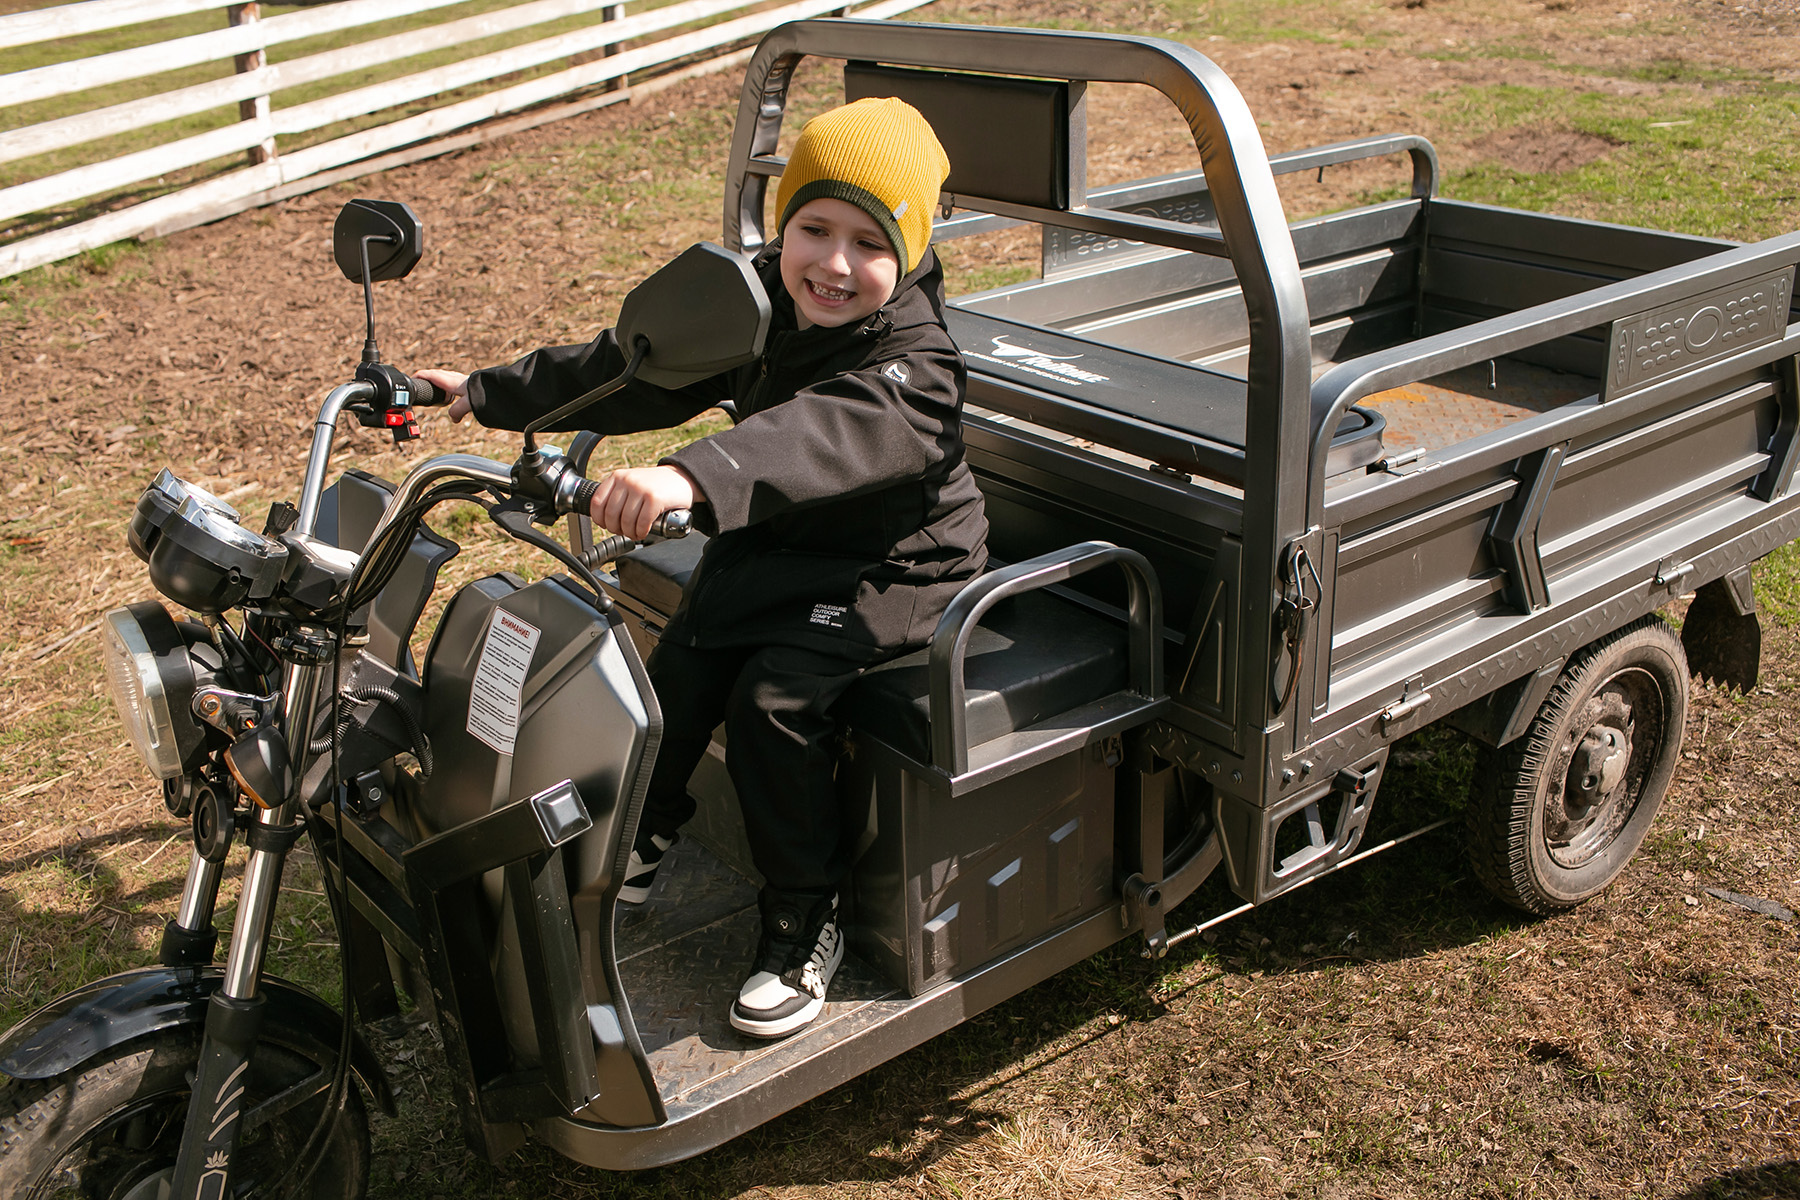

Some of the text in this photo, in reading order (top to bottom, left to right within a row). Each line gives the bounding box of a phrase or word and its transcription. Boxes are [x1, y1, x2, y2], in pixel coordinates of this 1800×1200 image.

[812, 608, 840, 617] OUTDOOR
[814, 603, 847, 613] ATHLEISURE
[501, 616, 531, 639] ВНИМАНИЕ!
